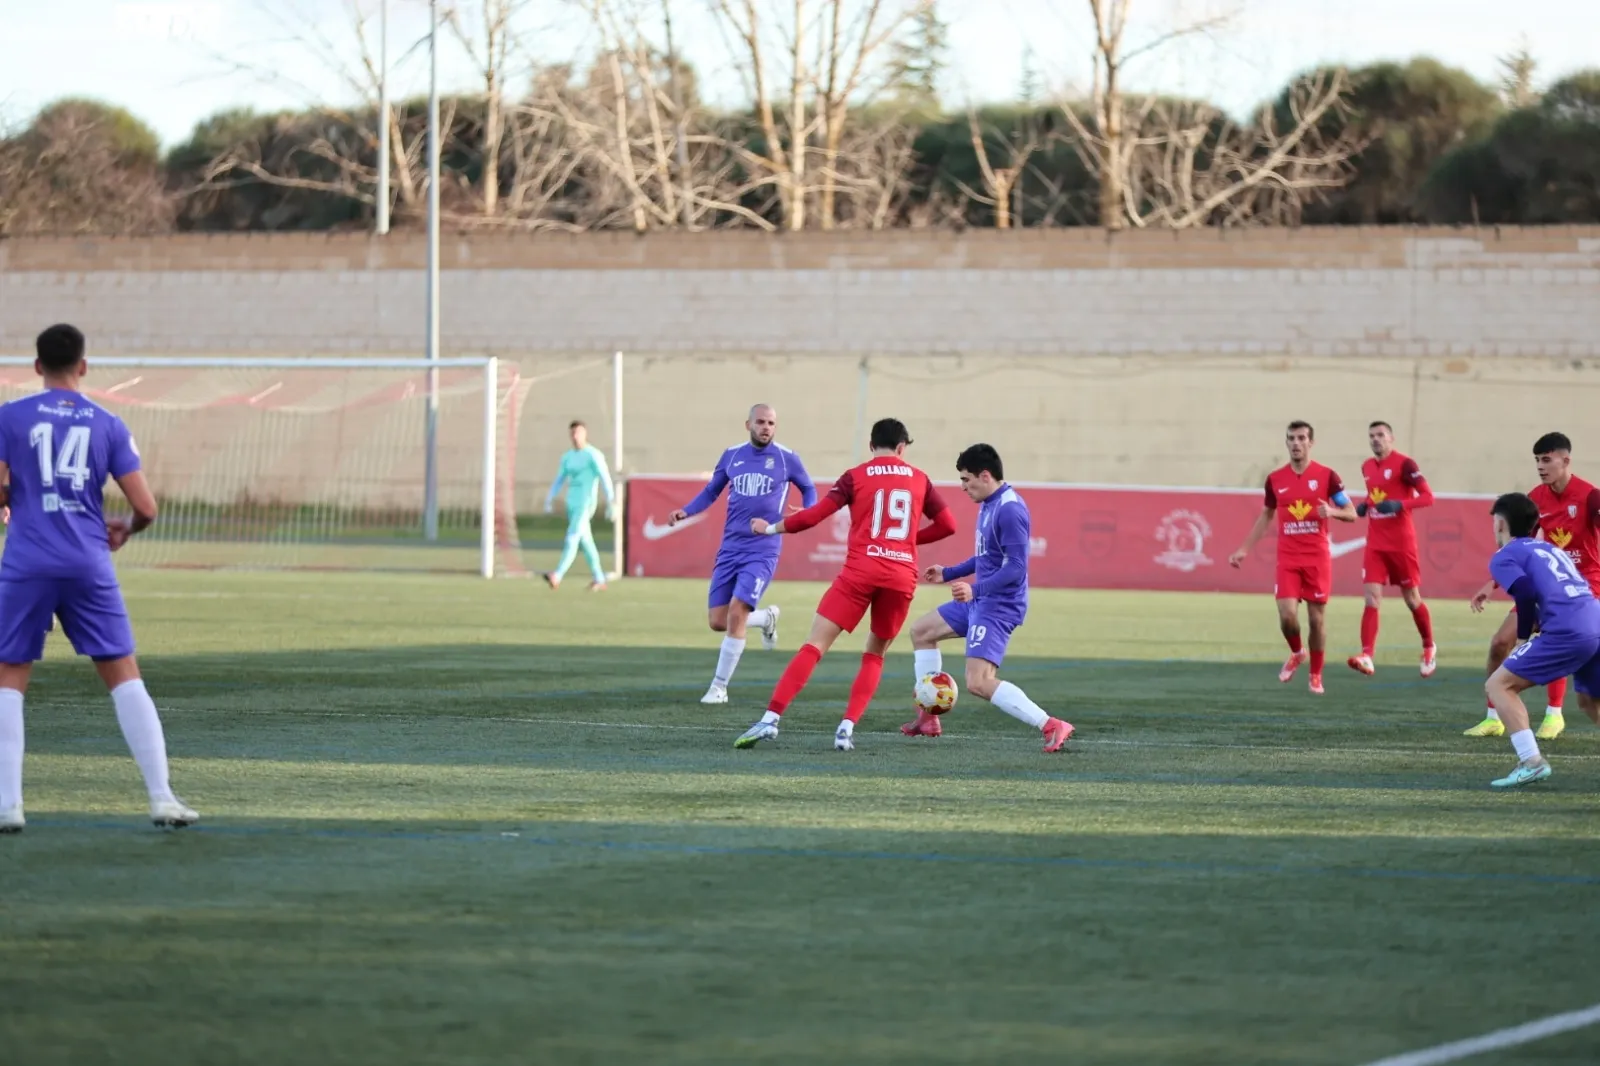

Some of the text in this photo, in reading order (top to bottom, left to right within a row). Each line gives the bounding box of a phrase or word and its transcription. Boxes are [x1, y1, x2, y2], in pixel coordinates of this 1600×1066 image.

[30, 422, 91, 491] 14
[871, 488, 912, 541] 19
[1534, 547, 1585, 582] 20
[970, 625, 987, 641] 19
